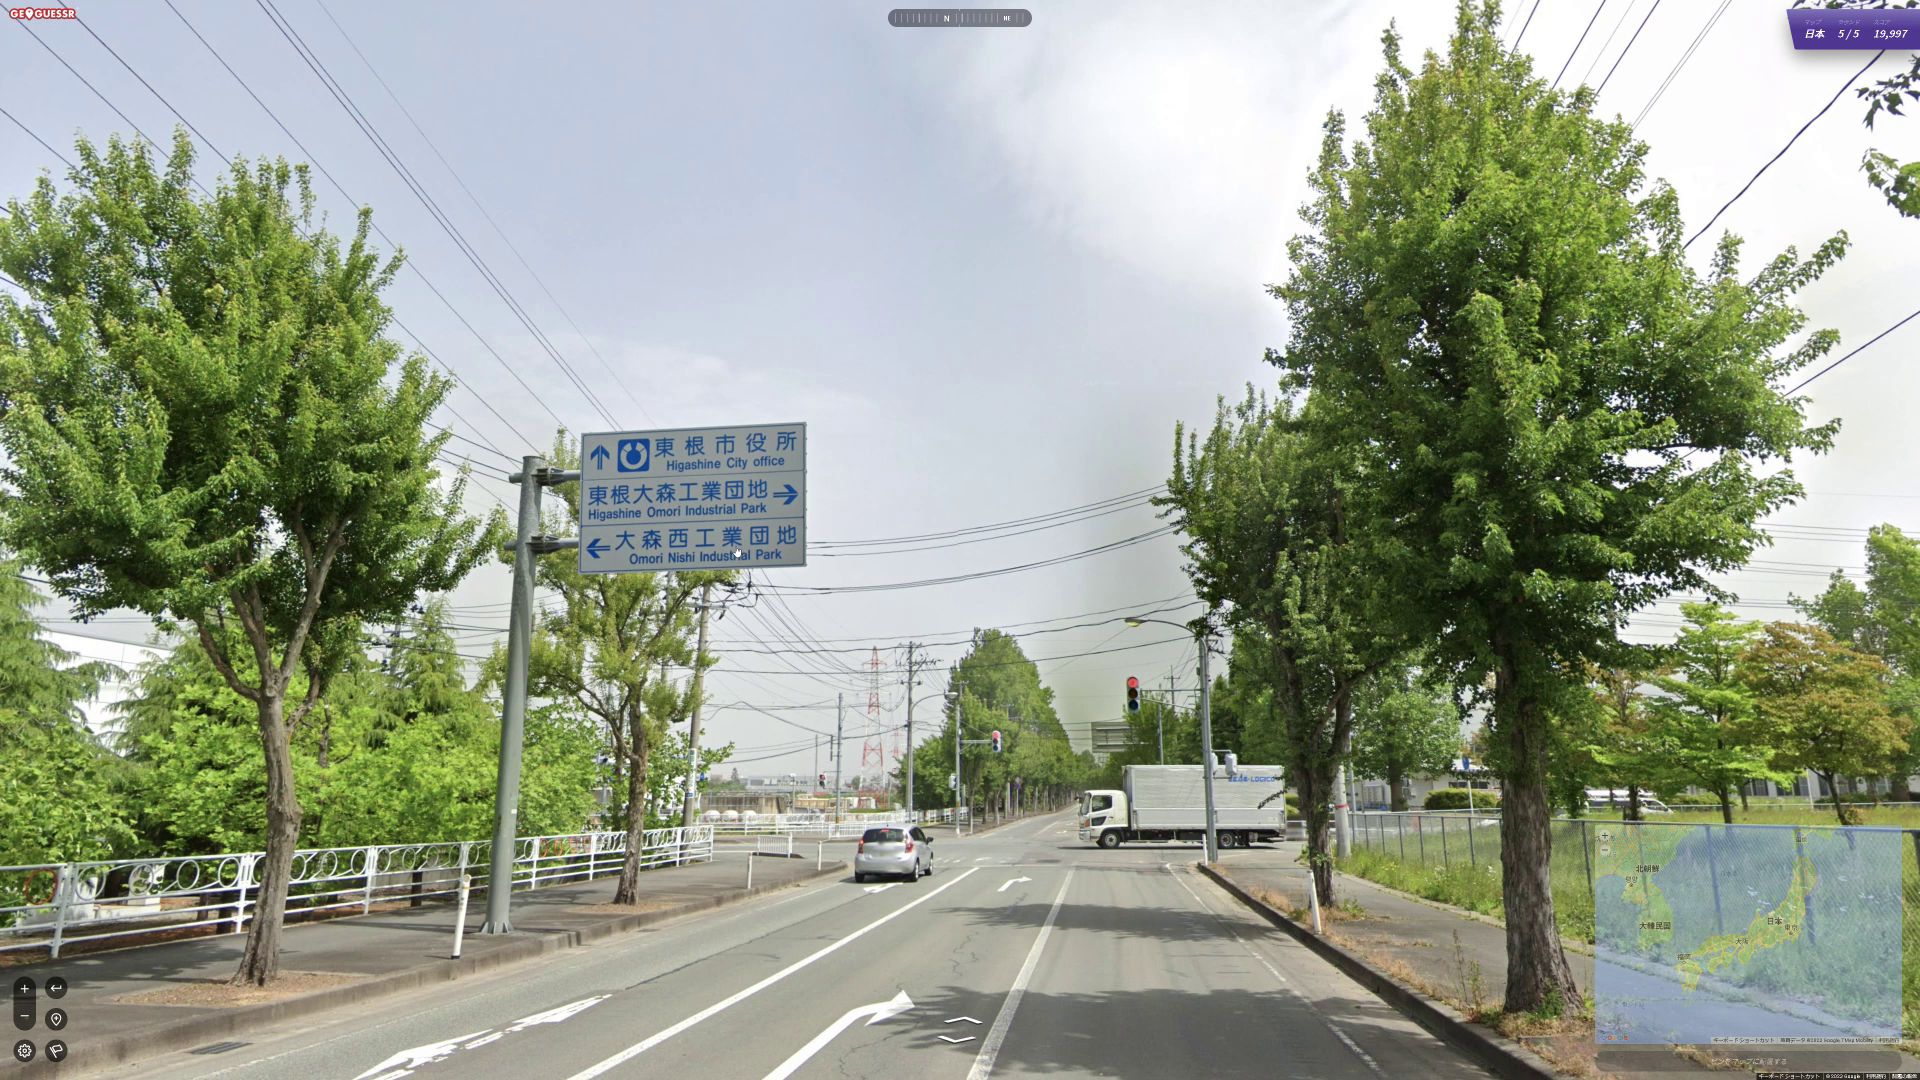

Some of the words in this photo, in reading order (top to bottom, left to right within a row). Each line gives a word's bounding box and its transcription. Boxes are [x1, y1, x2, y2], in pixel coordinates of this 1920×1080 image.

[654, 431, 797, 458] 東根市役所
[666, 459, 721, 472] Higashine
[726, 457, 748, 469] City
[753, 455, 785, 467] office
[588, 479, 768, 506] 東根大森工業団地
[588, 508, 641, 521] Higashine
[647, 506, 681, 518] Omori
[685, 503, 736, 516] Industrial
[741, 502, 767, 514] Park
[615, 524, 797, 551] 大森西工業団地
[629, 553, 663, 565] Omori
[668, 551, 695, 563] Nishi
[756, 548, 782, 560] Park
